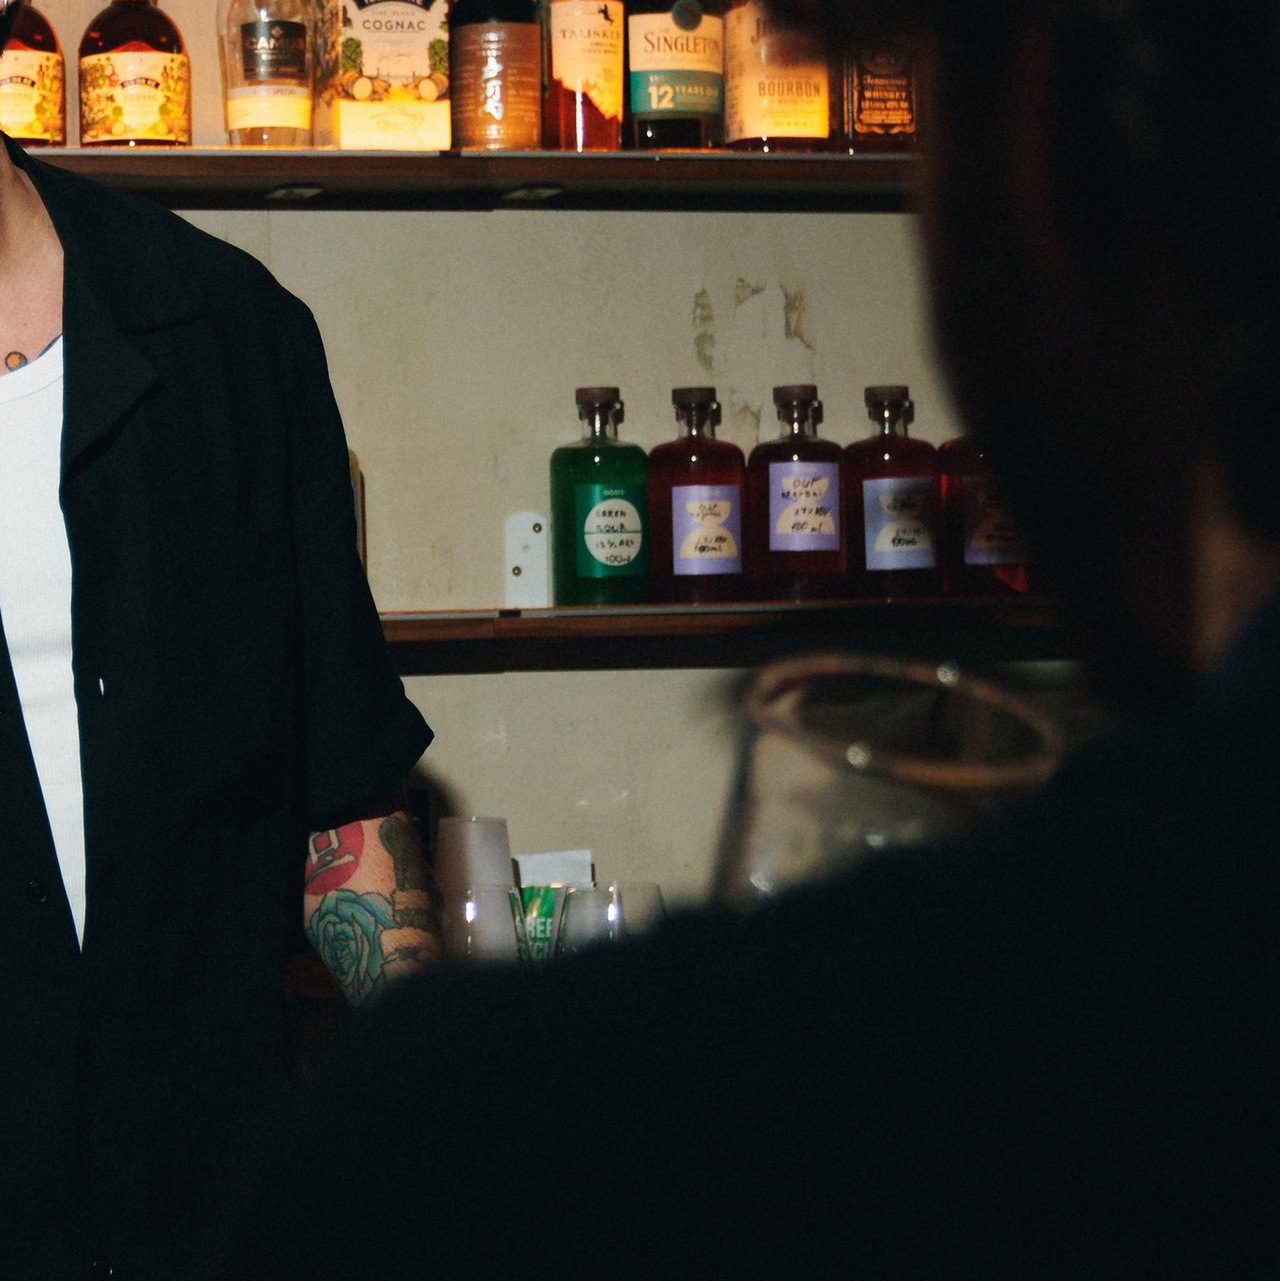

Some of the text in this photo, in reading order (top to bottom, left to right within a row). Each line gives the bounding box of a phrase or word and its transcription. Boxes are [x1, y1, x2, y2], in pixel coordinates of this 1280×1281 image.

[362, 20, 426, 31] COGNAC
[648, 84, 674, 110] 12
[758, 81, 820, 98] BOURBON
